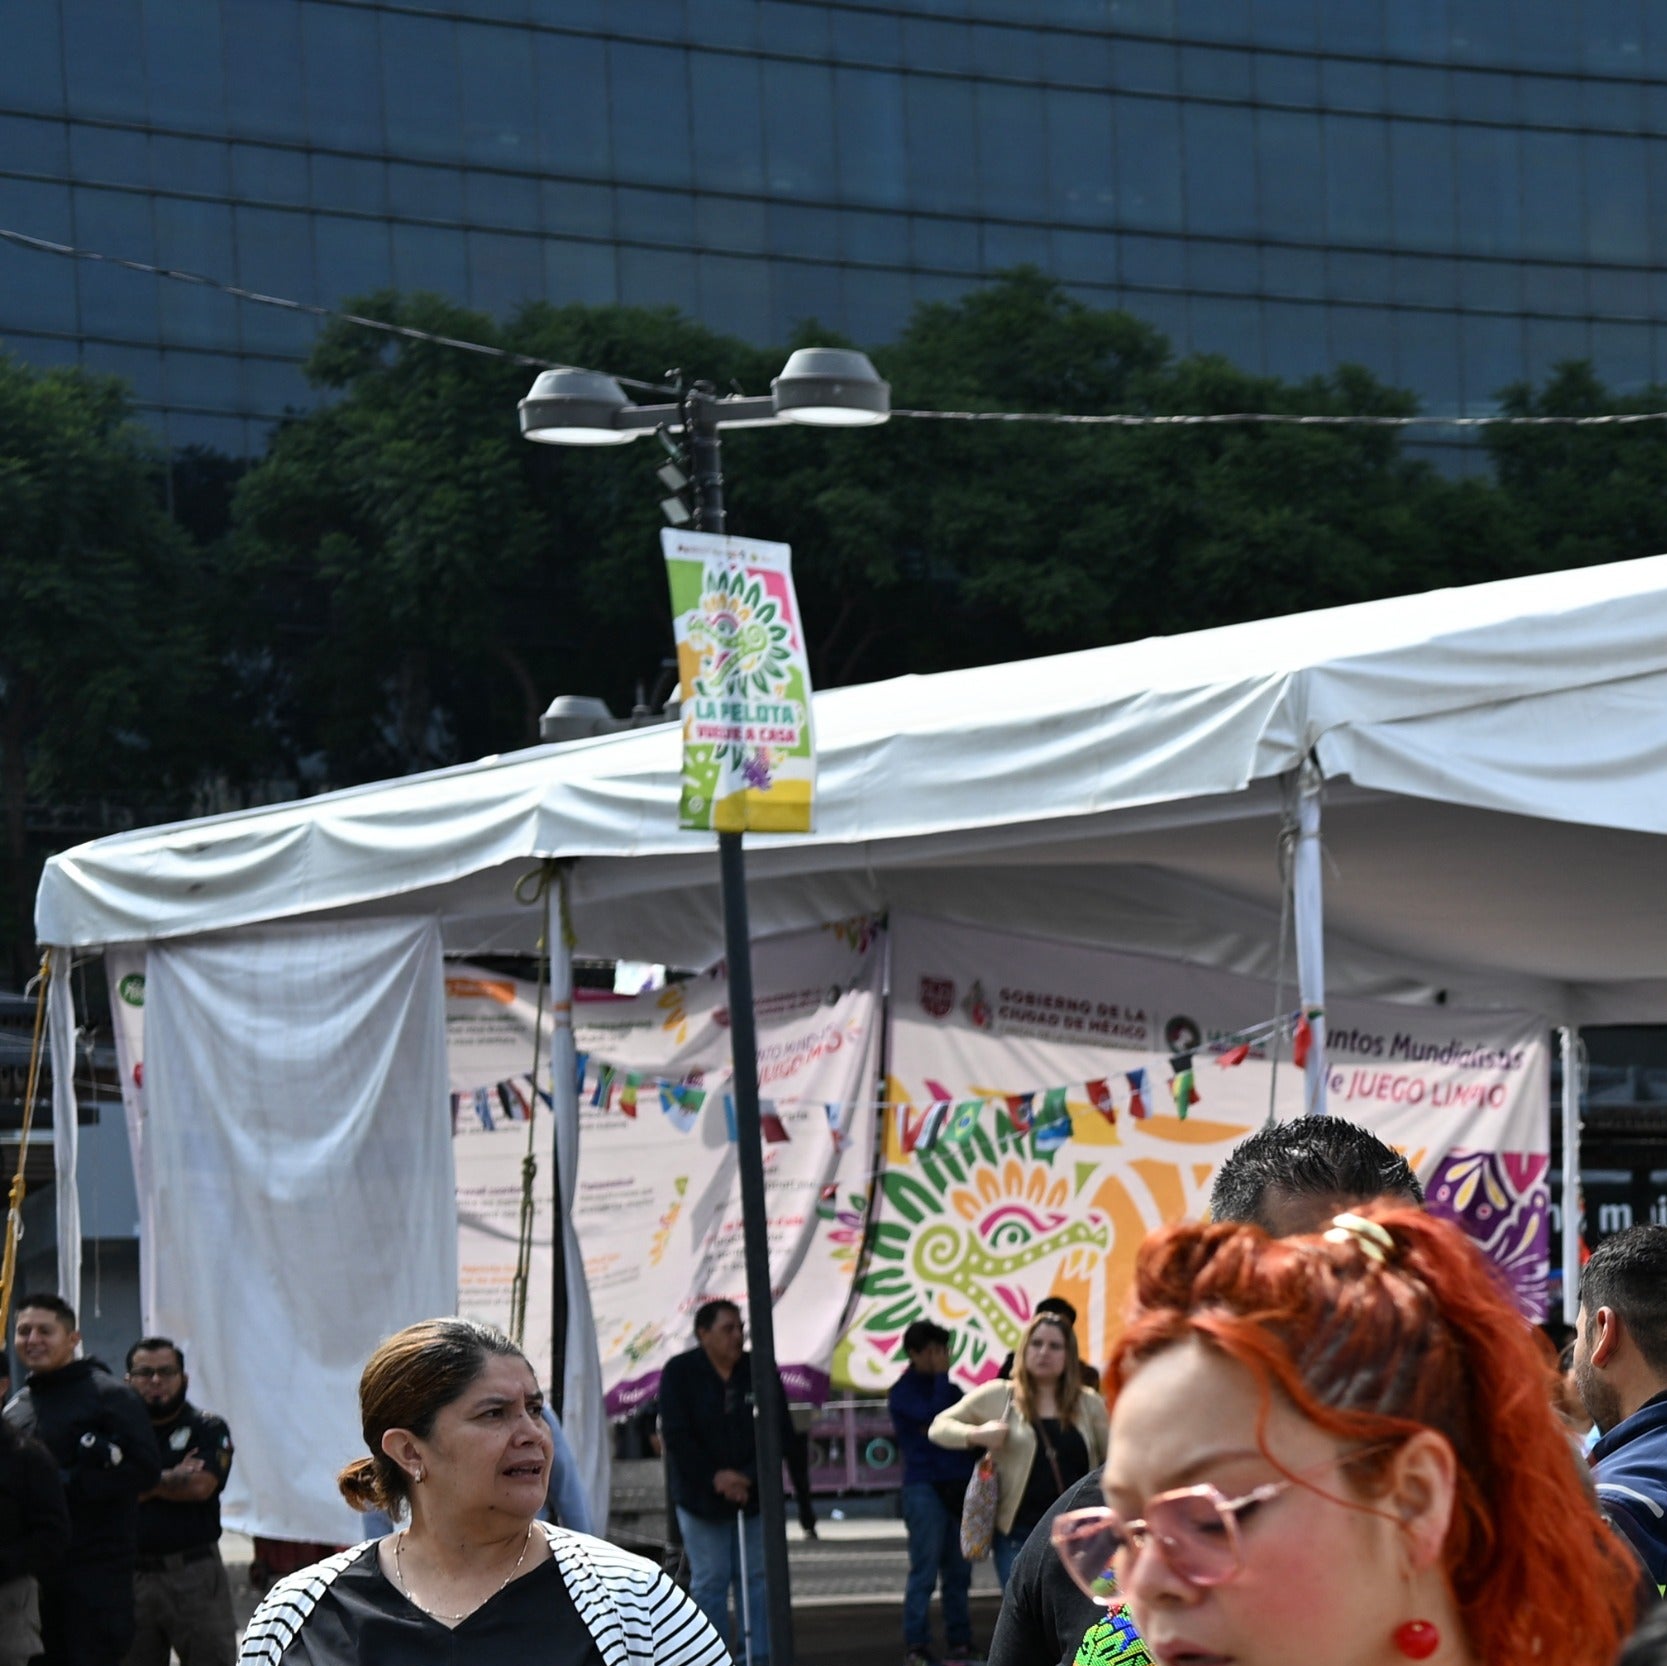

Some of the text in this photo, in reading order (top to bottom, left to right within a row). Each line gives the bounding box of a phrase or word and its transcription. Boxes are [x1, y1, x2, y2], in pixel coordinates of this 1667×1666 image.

[696, 700, 794, 724] LA PELOTA
[759, 727, 795, 743] CASA
[1000, 987, 1146, 1022] GOBIERNO DE LA
[999, 1005, 1059, 1027] CIUDAD
[1063, 1016, 1083, 1030] DE
[1346, 1069, 1425, 1106] JUEGO
